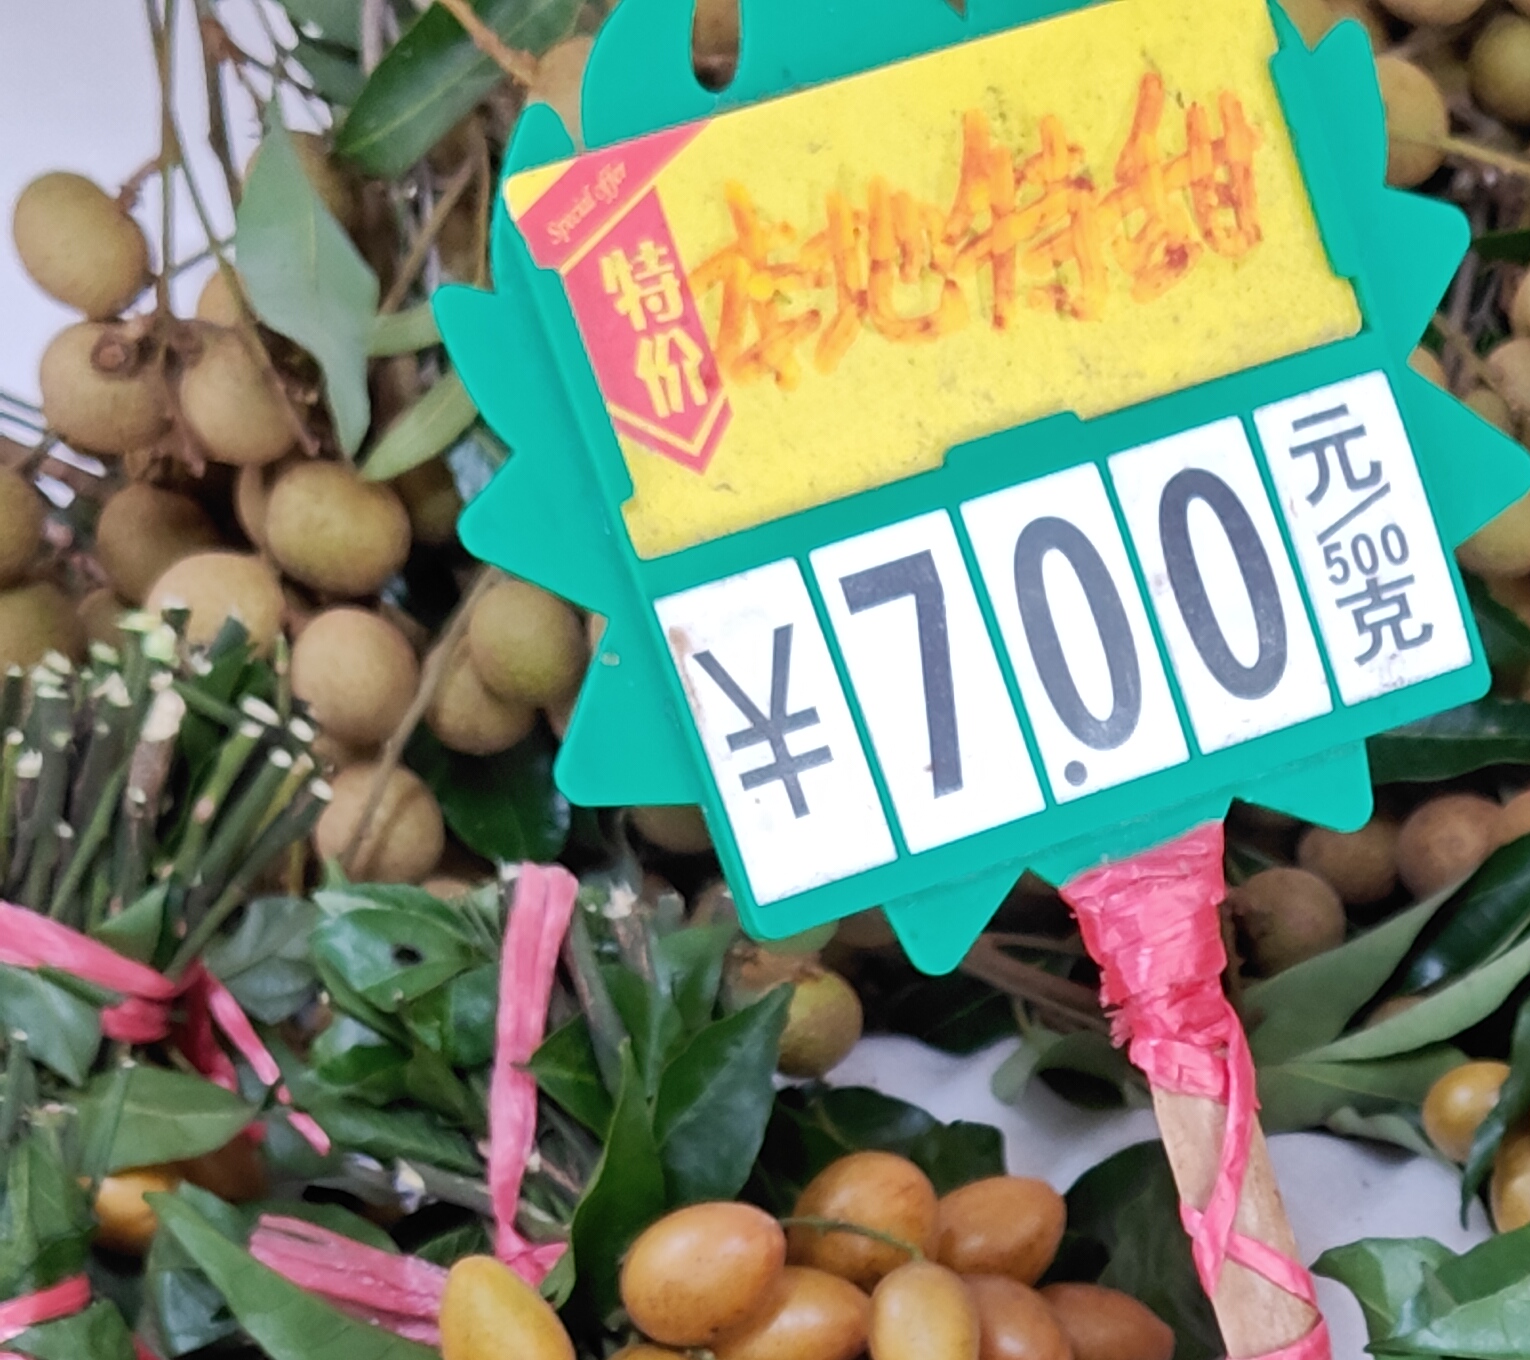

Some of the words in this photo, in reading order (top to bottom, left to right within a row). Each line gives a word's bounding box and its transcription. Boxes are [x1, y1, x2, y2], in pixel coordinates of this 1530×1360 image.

[547, 184, 596, 244] Special
[594, 161, 627, 205] offer
[600, 240, 709, 418] 特价
